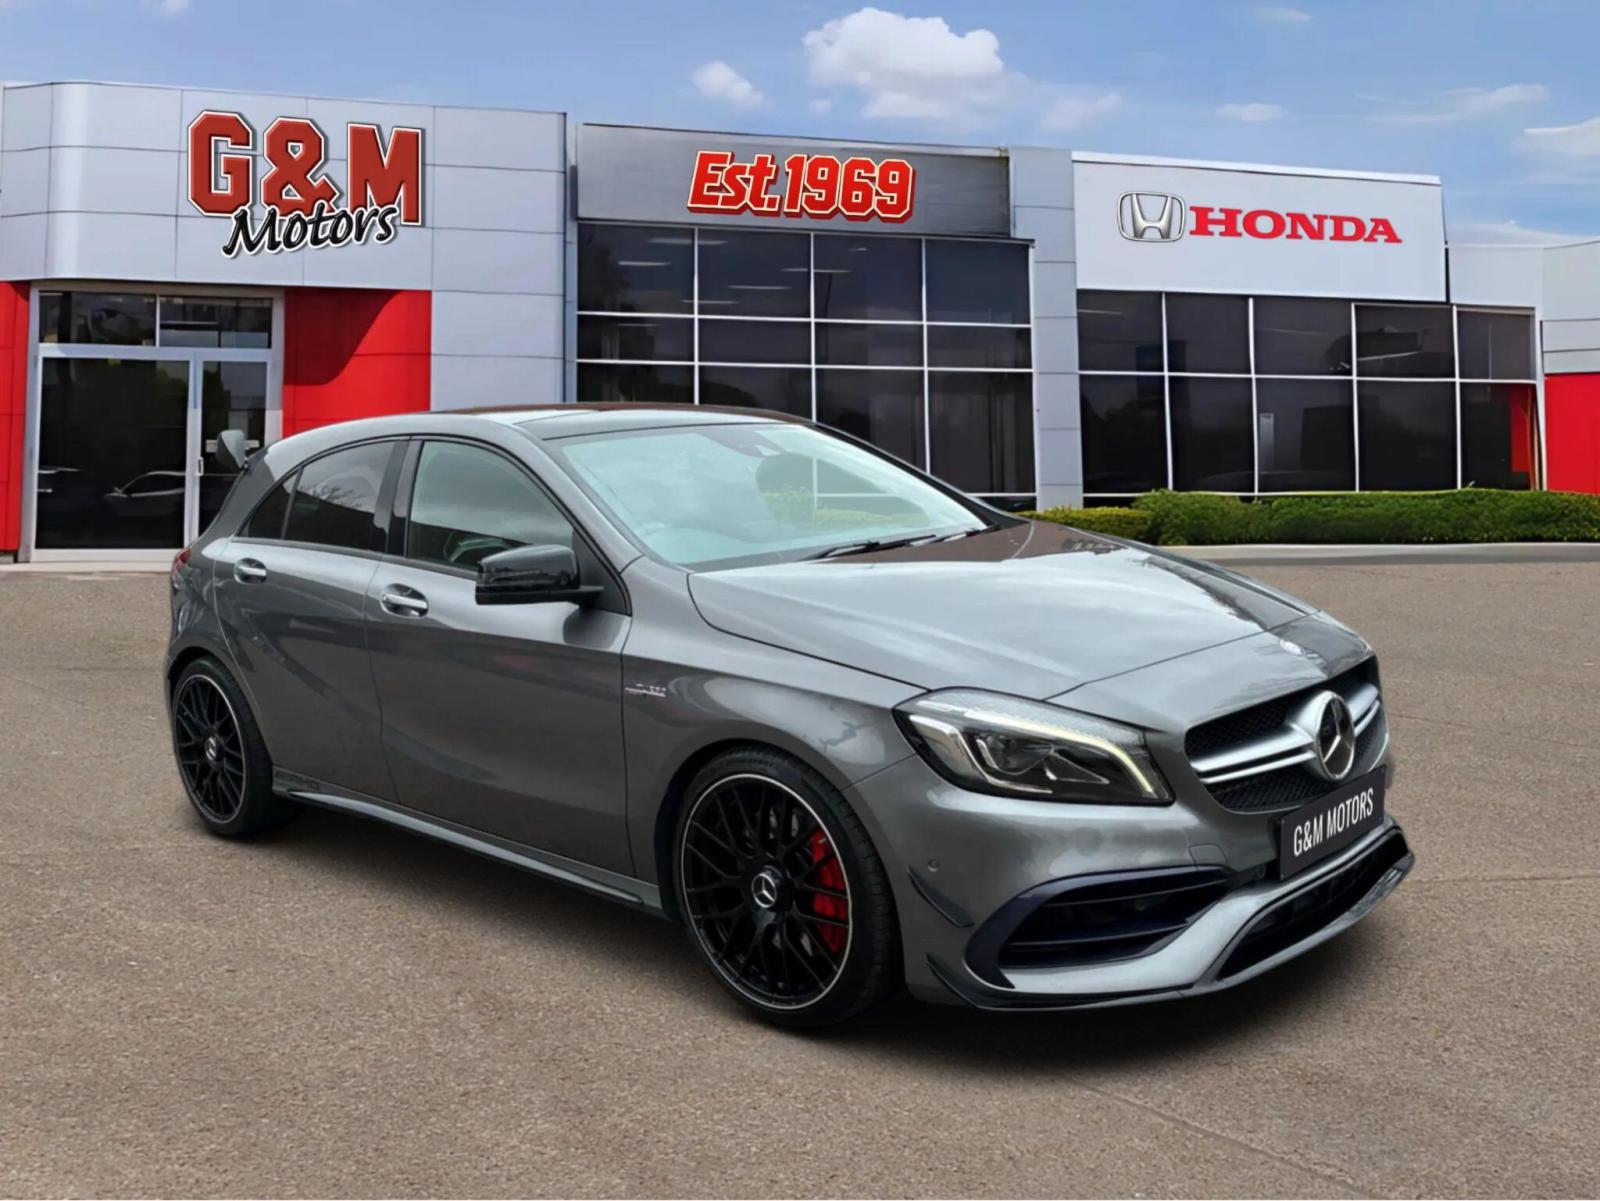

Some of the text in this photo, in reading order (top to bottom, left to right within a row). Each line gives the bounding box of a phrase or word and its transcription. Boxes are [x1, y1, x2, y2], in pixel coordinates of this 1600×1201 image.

[188, 109, 423, 226] G&M
[222, 200, 400, 258] Motors
[1189, 206, 1402, 243] HONDA
[1293, 787, 1374, 857] G&M MOTORS
